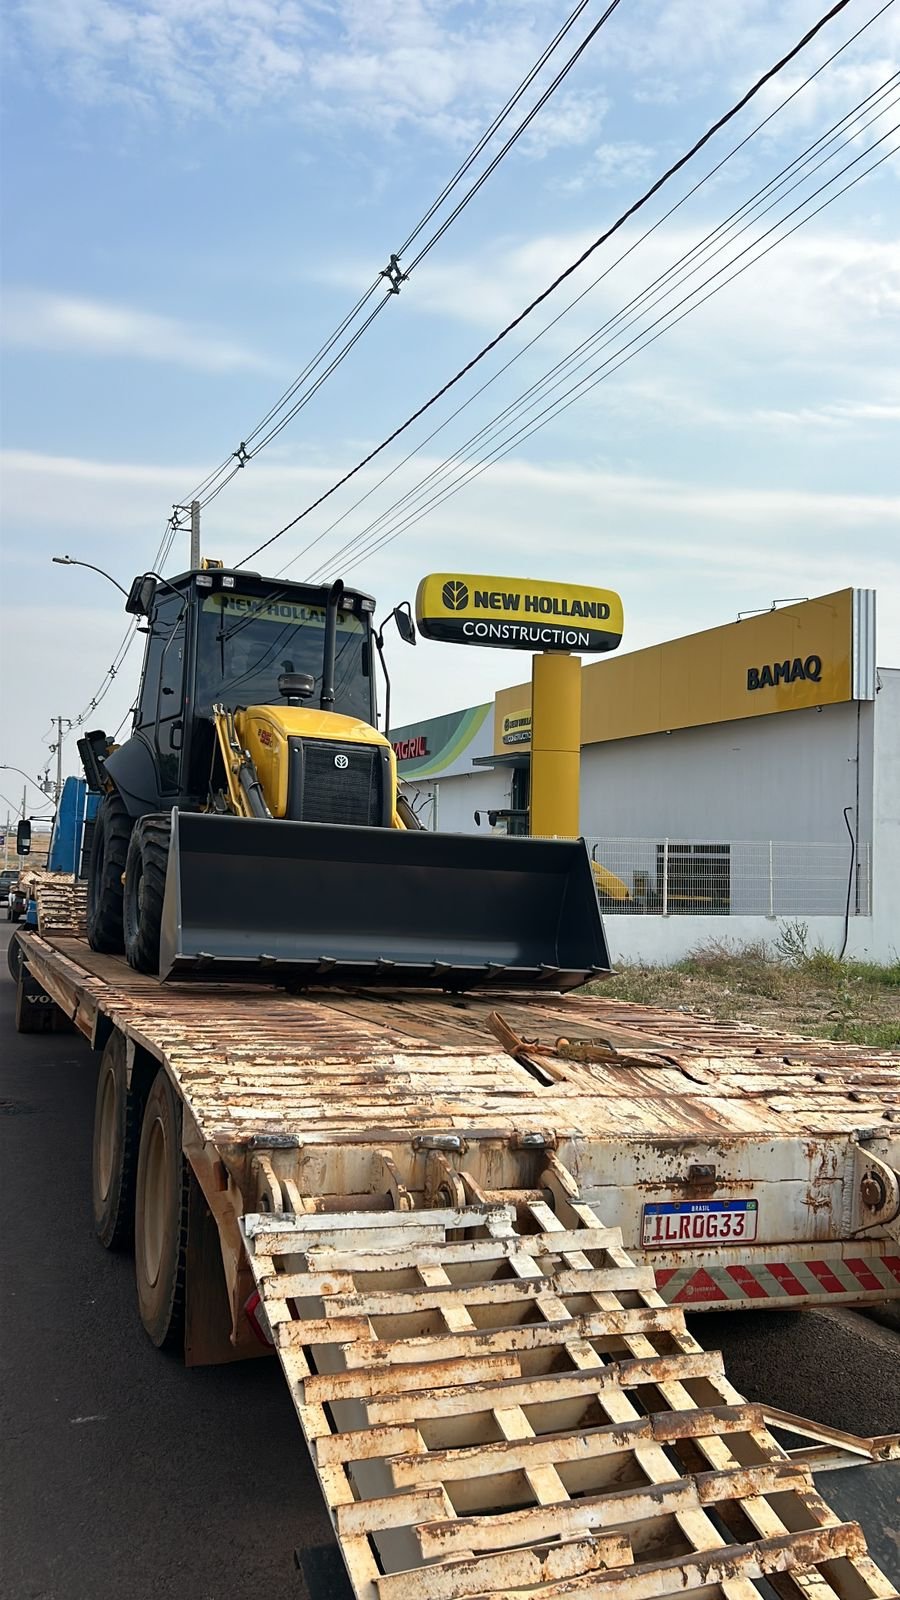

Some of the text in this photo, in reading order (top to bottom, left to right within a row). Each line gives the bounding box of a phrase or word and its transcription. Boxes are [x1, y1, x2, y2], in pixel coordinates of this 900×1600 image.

[474, 591, 610, 619] NEW HOLLAND
[463, 622, 590, 646] CONSTRUCTION
[747, 655, 822, 690] BAMAQ
